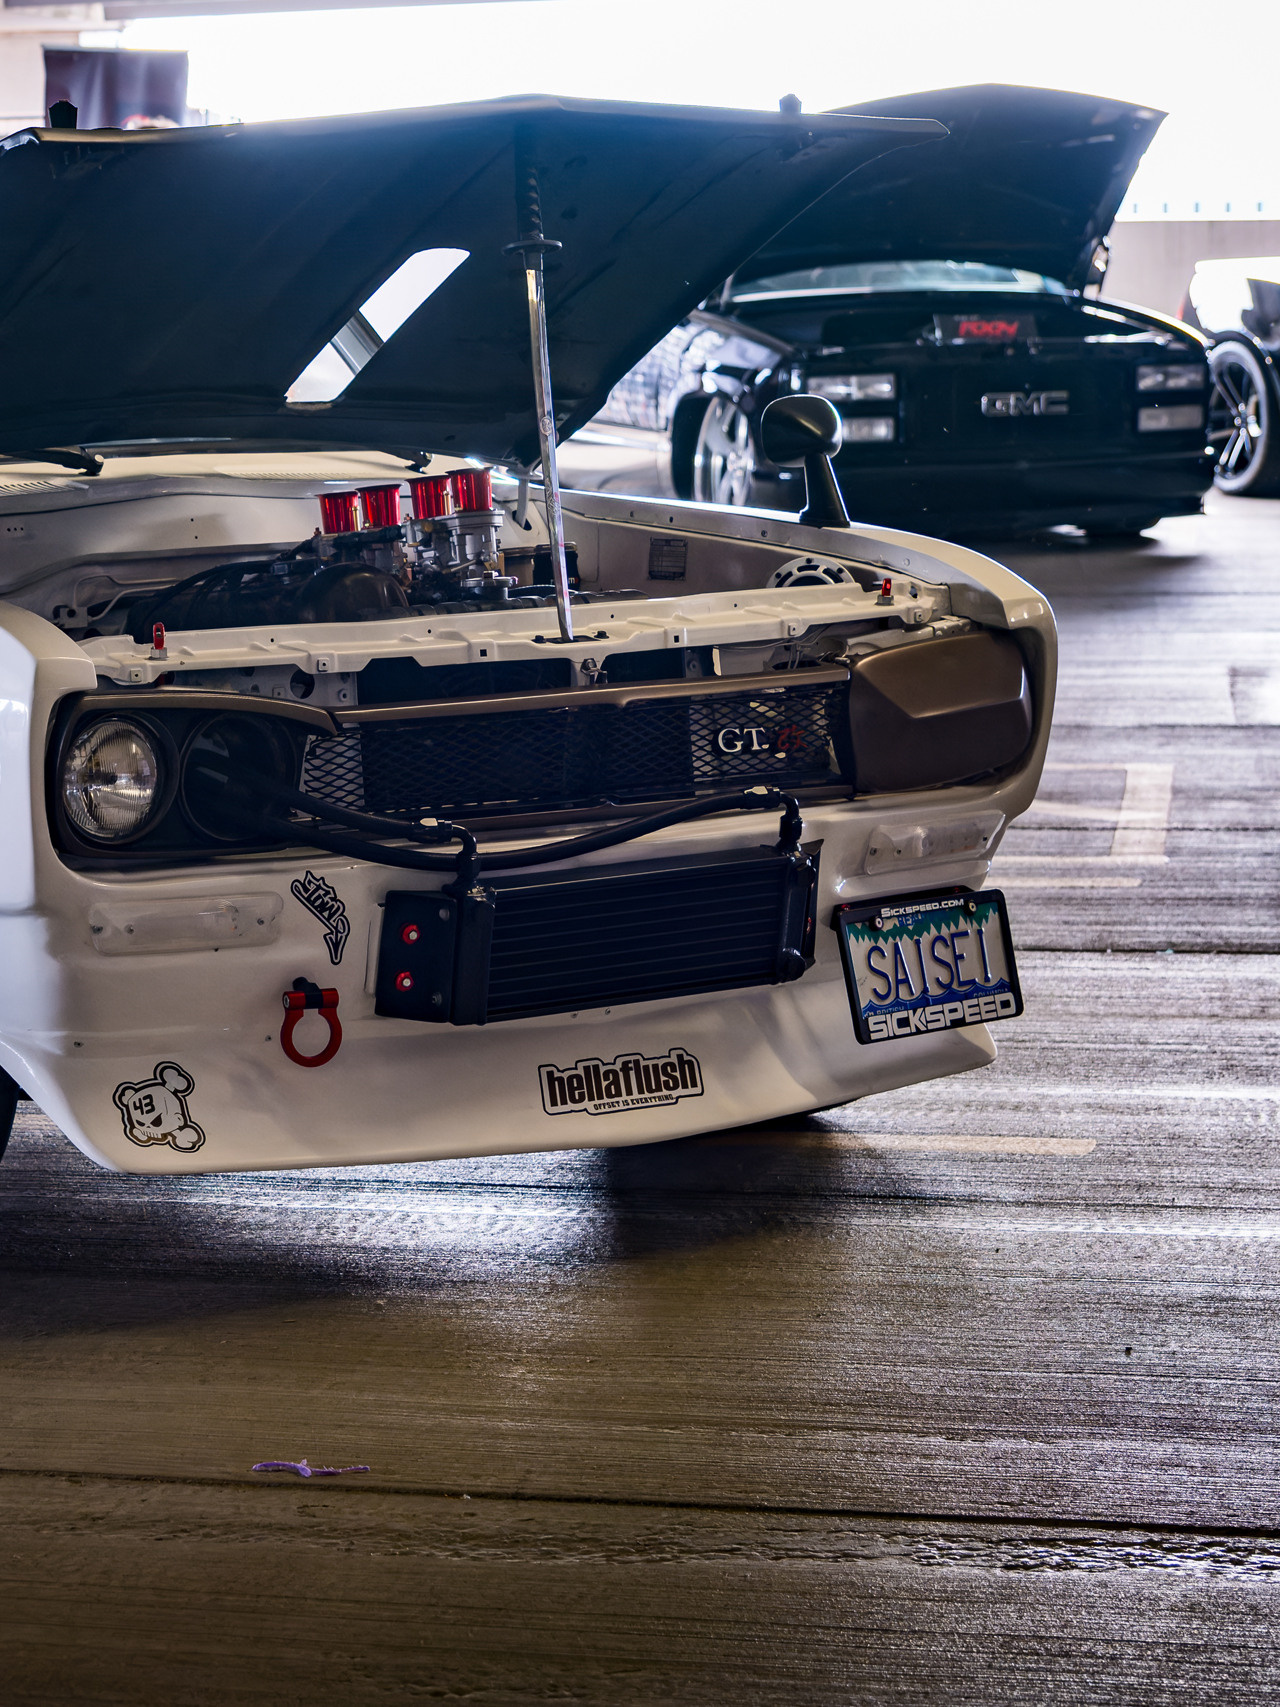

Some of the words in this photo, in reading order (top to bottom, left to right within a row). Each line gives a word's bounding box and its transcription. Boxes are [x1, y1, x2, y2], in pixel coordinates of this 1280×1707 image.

[980, 390, 1070, 418] GMC
[866, 927, 992, 1002] SAISEI
[868, 991, 1017, 1041] SICKSPEED
[546, 1053, 699, 1108] hellaflush
[132, 1093, 156, 1116] 43
[593, 1100, 621, 1111] OFFSET
[622, 1099, 630, 1107] IS
